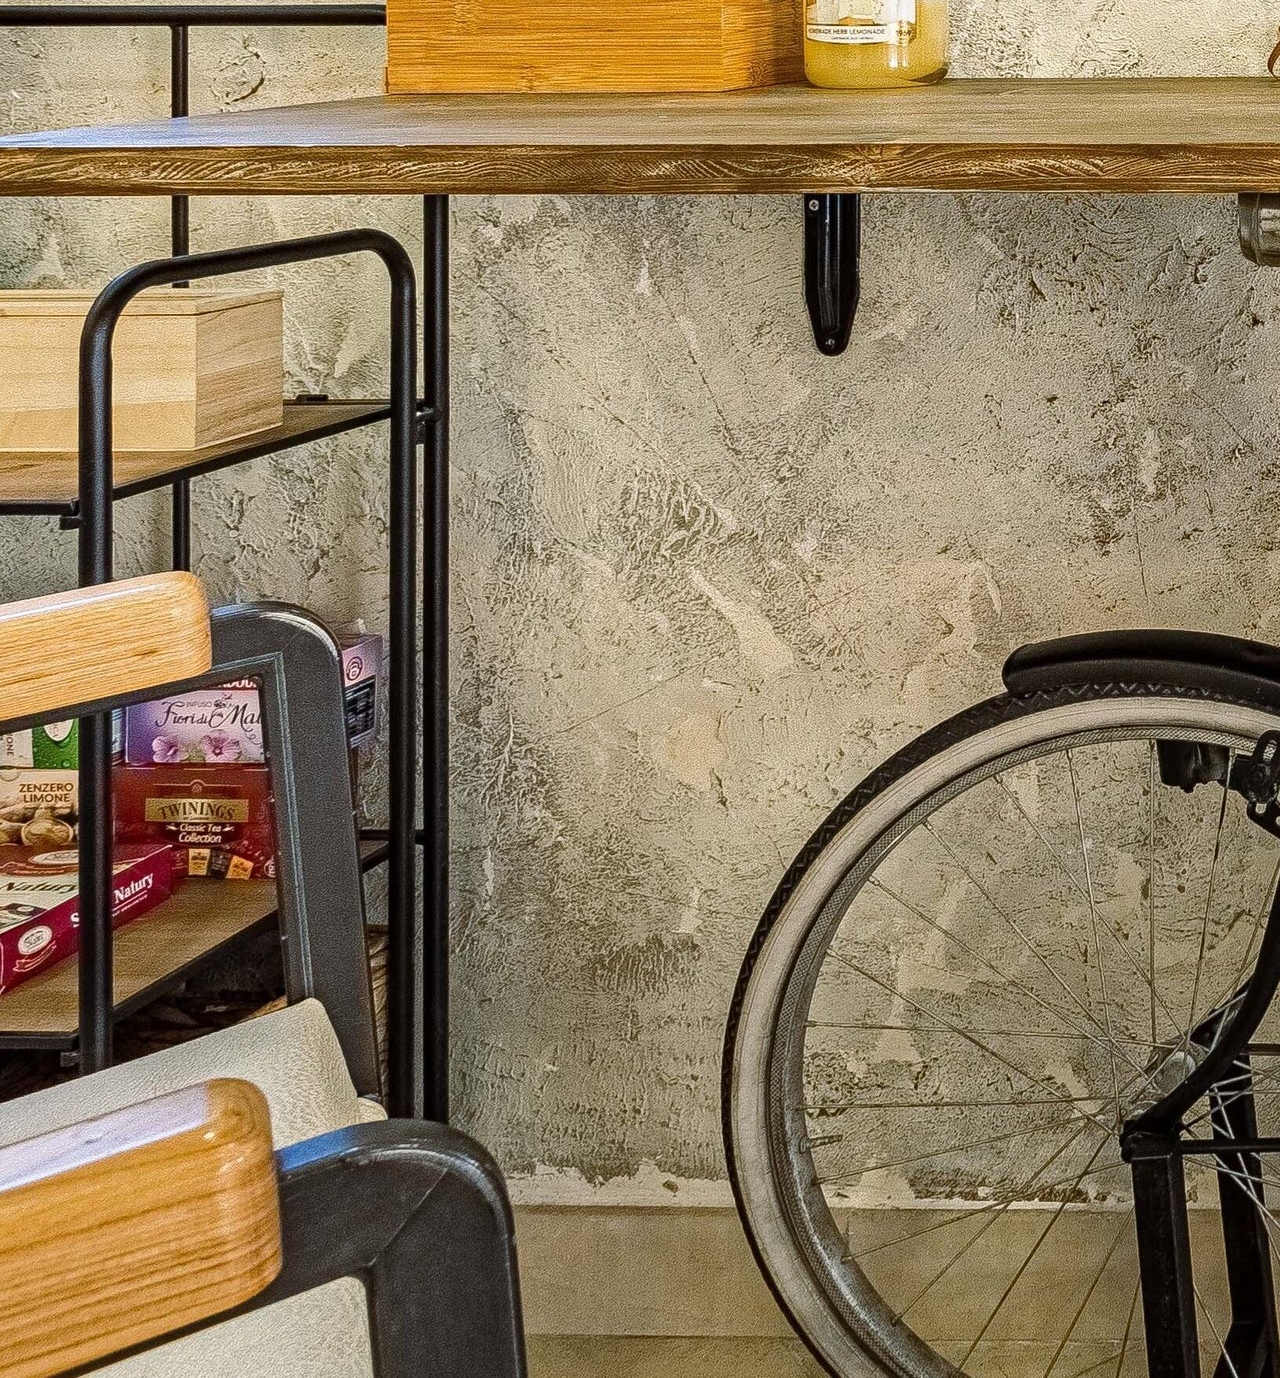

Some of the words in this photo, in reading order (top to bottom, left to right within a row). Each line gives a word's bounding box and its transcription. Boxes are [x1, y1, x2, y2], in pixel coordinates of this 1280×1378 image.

[155, 702, 195, 728] Fiori
[196, 713, 208, 724] di
[208, 703, 260, 732] Mal
[19, 783, 74, 793] ZENZERO
[23, 793, 70, 803] LIMONE
[158, 802, 236, 820] TWININGS
[179, 823, 205, 832] Classic
[208, 823, 222, 832] Tea
[178, 832, 222, 843] Collection
[113, 873, 153, 904] Natury
